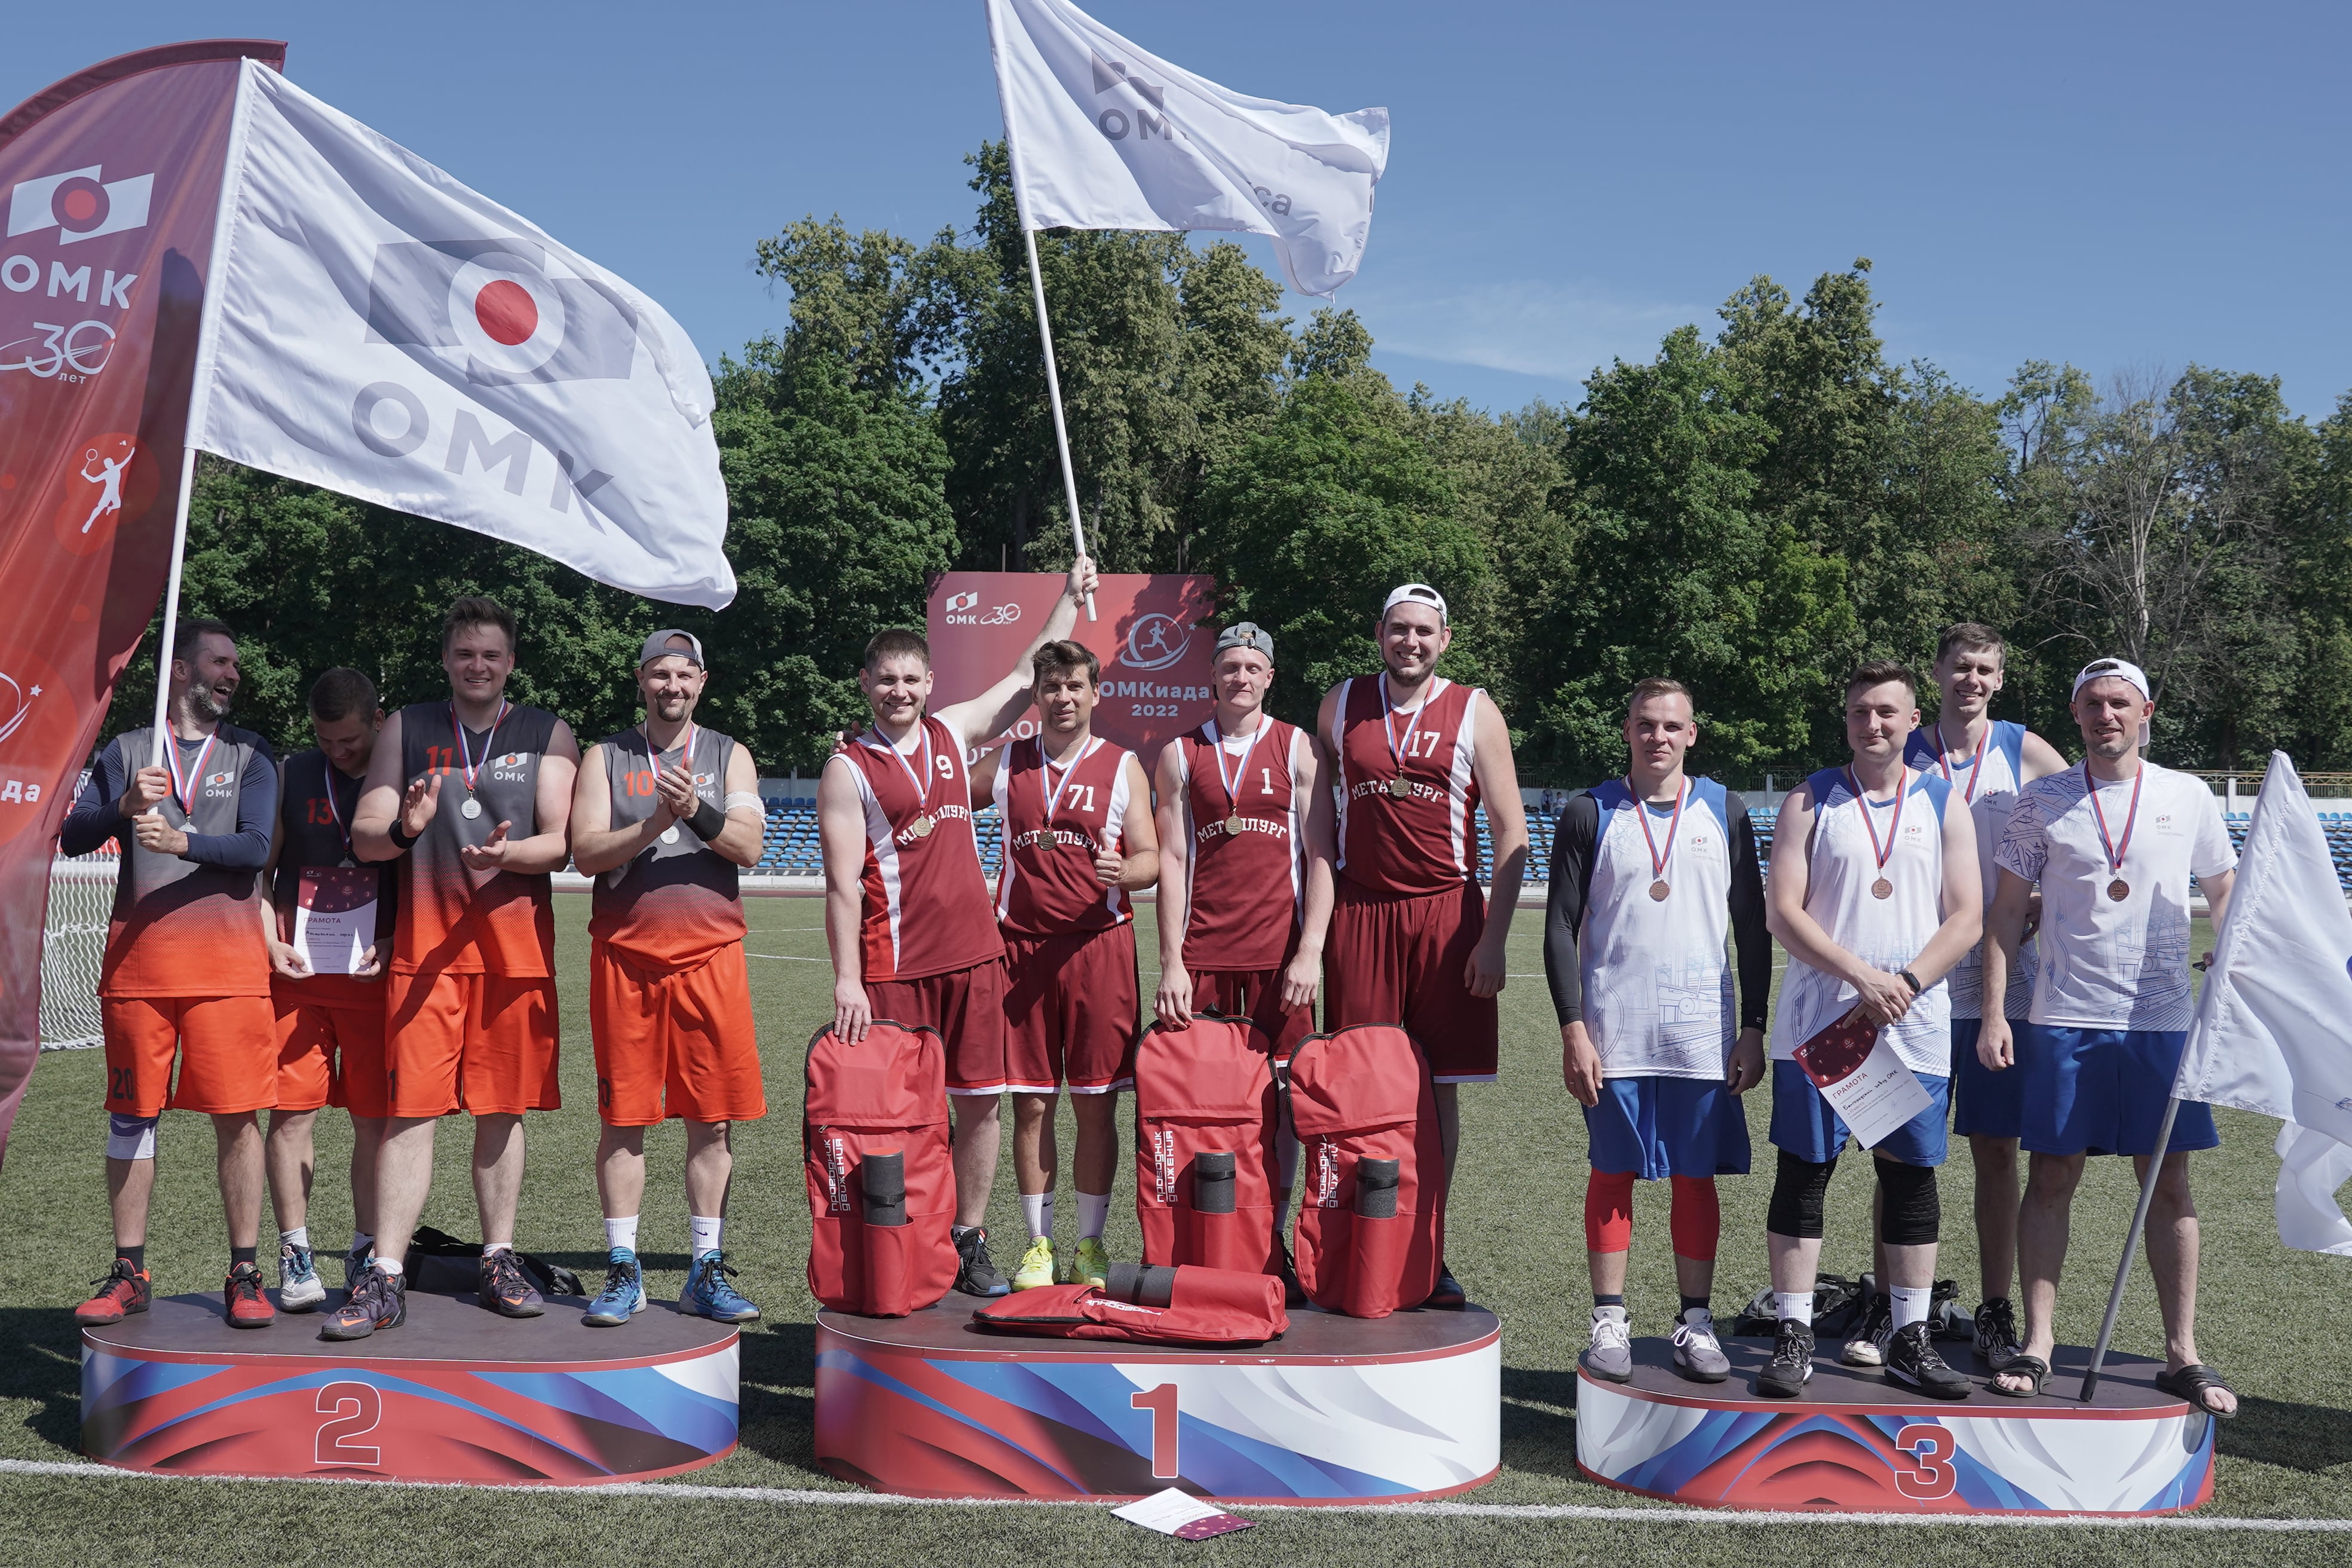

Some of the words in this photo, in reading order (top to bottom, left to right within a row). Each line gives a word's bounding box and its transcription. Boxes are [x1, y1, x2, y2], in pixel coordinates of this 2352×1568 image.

[1099, 109, 1188, 141] ОМ
[1, 255, 138, 310] ОМК
[26, 320, 116, 378] 30
[59, 372, 87, 384] лет
[352, 381, 614, 535] ОМК
[946, 614, 976, 624] ОМК
[1100, 681, 1209, 701] ОМКиада
[1131, 704, 1178, 716] 2022
[1408, 730, 1441, 758] 17
[427, 745, 453, 776] 11
[935, 754, 954, 779] 9
[494, 771, 526, 782] ОМК
[624, 770, 654, 797] 10
[1261, 768, 1273, 794] 1
[205, 789, 233, 798] ОМК
[1068, 784, 1095, 812] 71
[1351, 779, 1444, 803] МЕТАУРГ
[307, 798, 333, 825] 13
[896, 805, 969, 846] МАЛЛУРГ
[1197, 817, 1287, 843] МЕТЛУРГ
[1013, 829, 1102, 851] МЕТЛЛУРГ
[112, 1067, 134, 1101] 20
[1833, 1073, 1868, 1099] ГРАМОТА
[314, 1380, 382, 1466] 2
[1131, 1383, 1179, 1478] 1
[1894, 1423, 1957, 1499] 3
